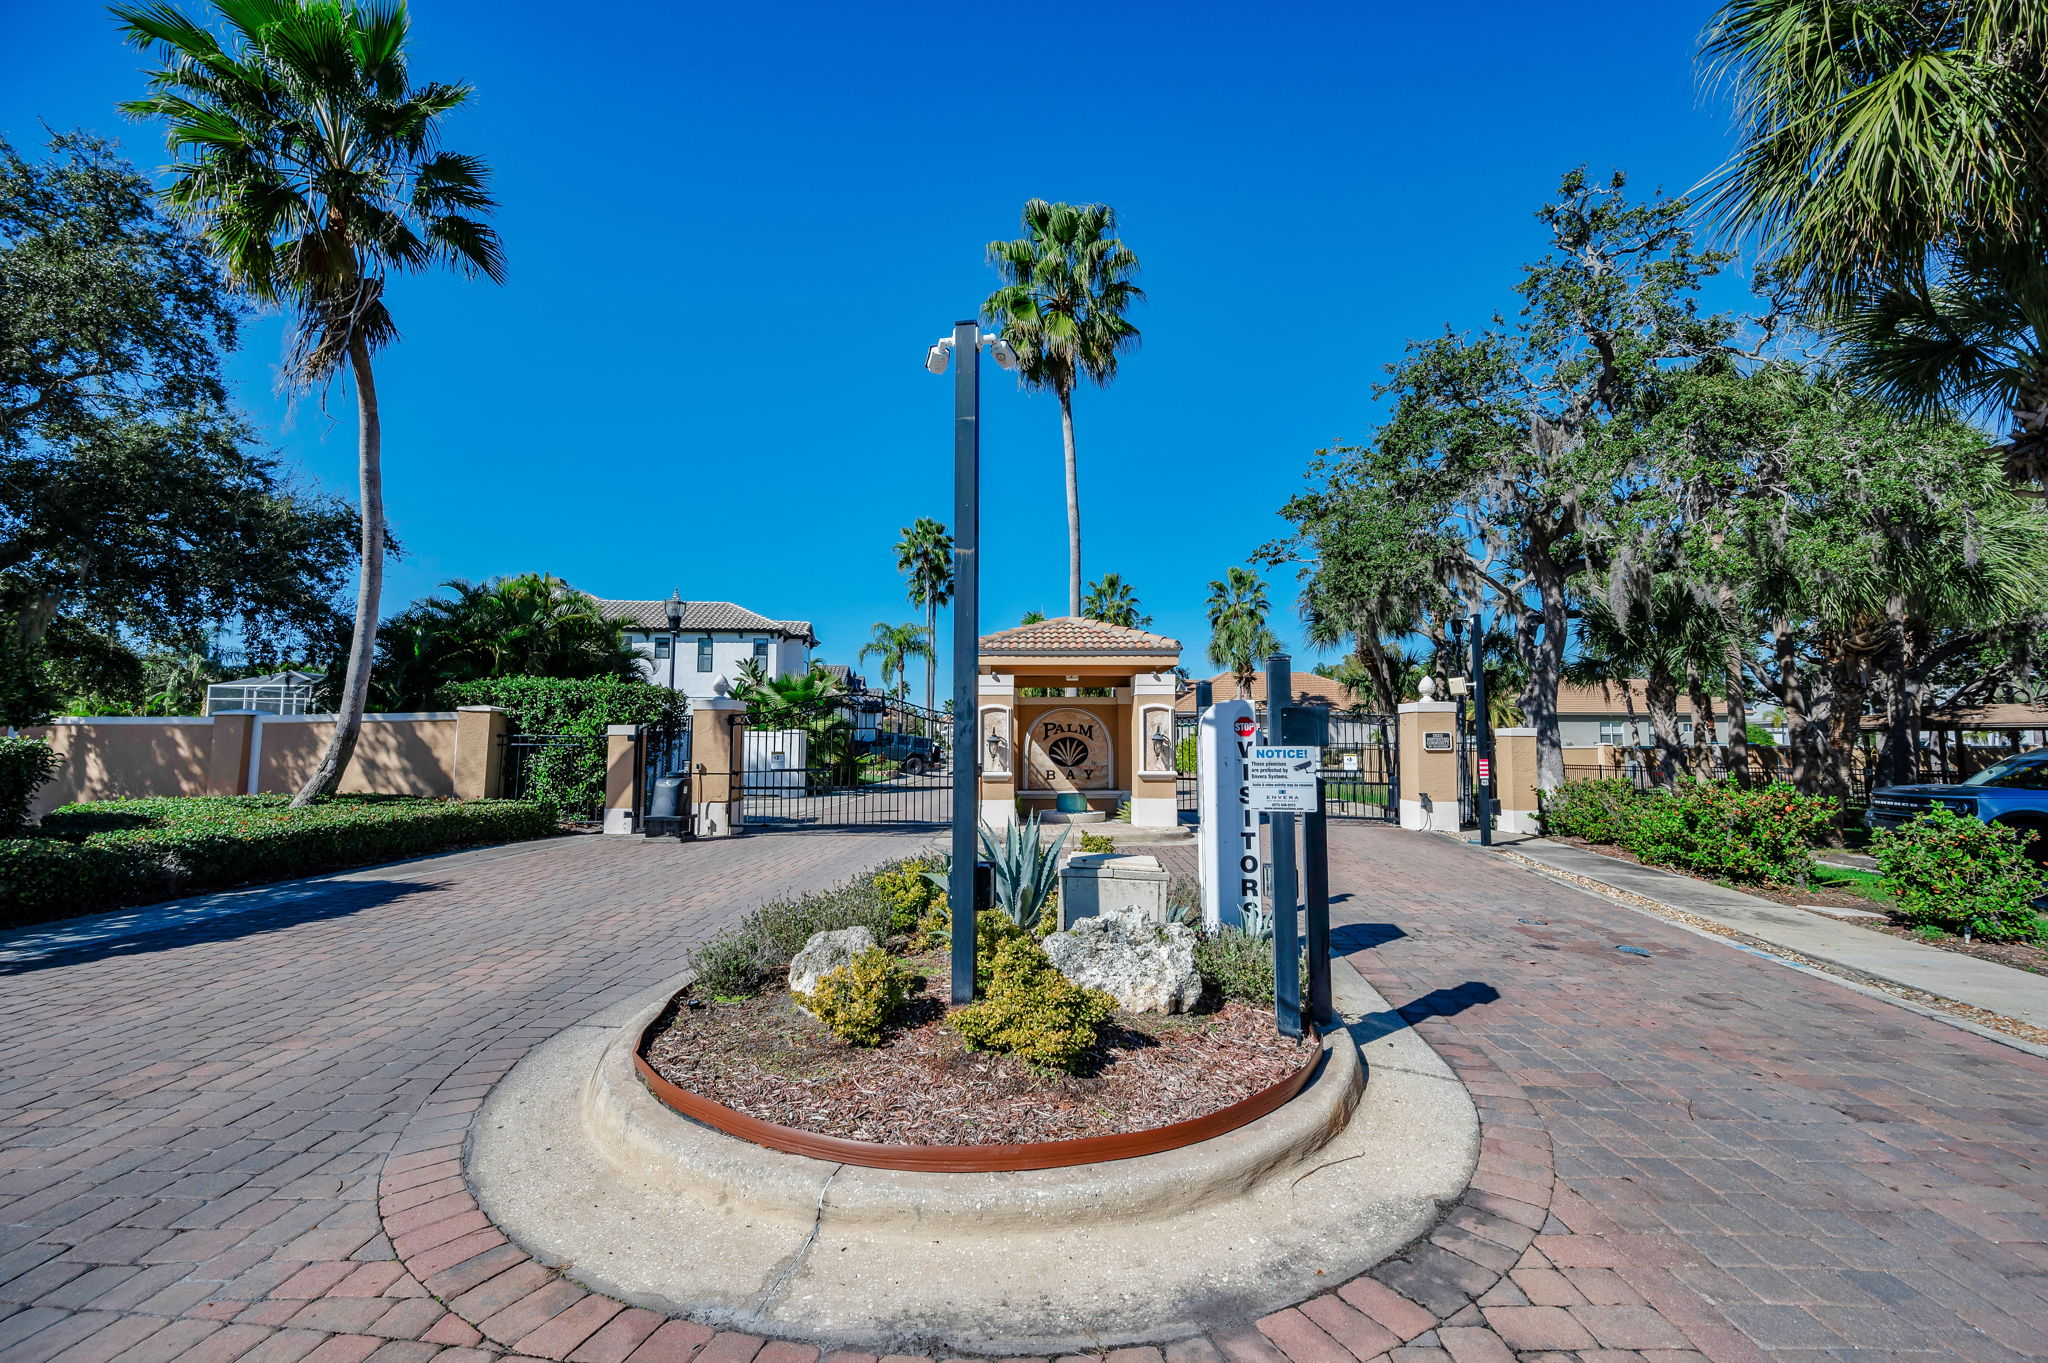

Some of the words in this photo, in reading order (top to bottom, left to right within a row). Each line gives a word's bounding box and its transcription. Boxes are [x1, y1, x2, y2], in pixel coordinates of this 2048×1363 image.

[1043, 722, 1094, 741] PALM
[1235, 722, 1254, 731] STOP
[1256, 749, 1308, 759] NOTICE!
[1045, 769, 1094, 781] BAY
